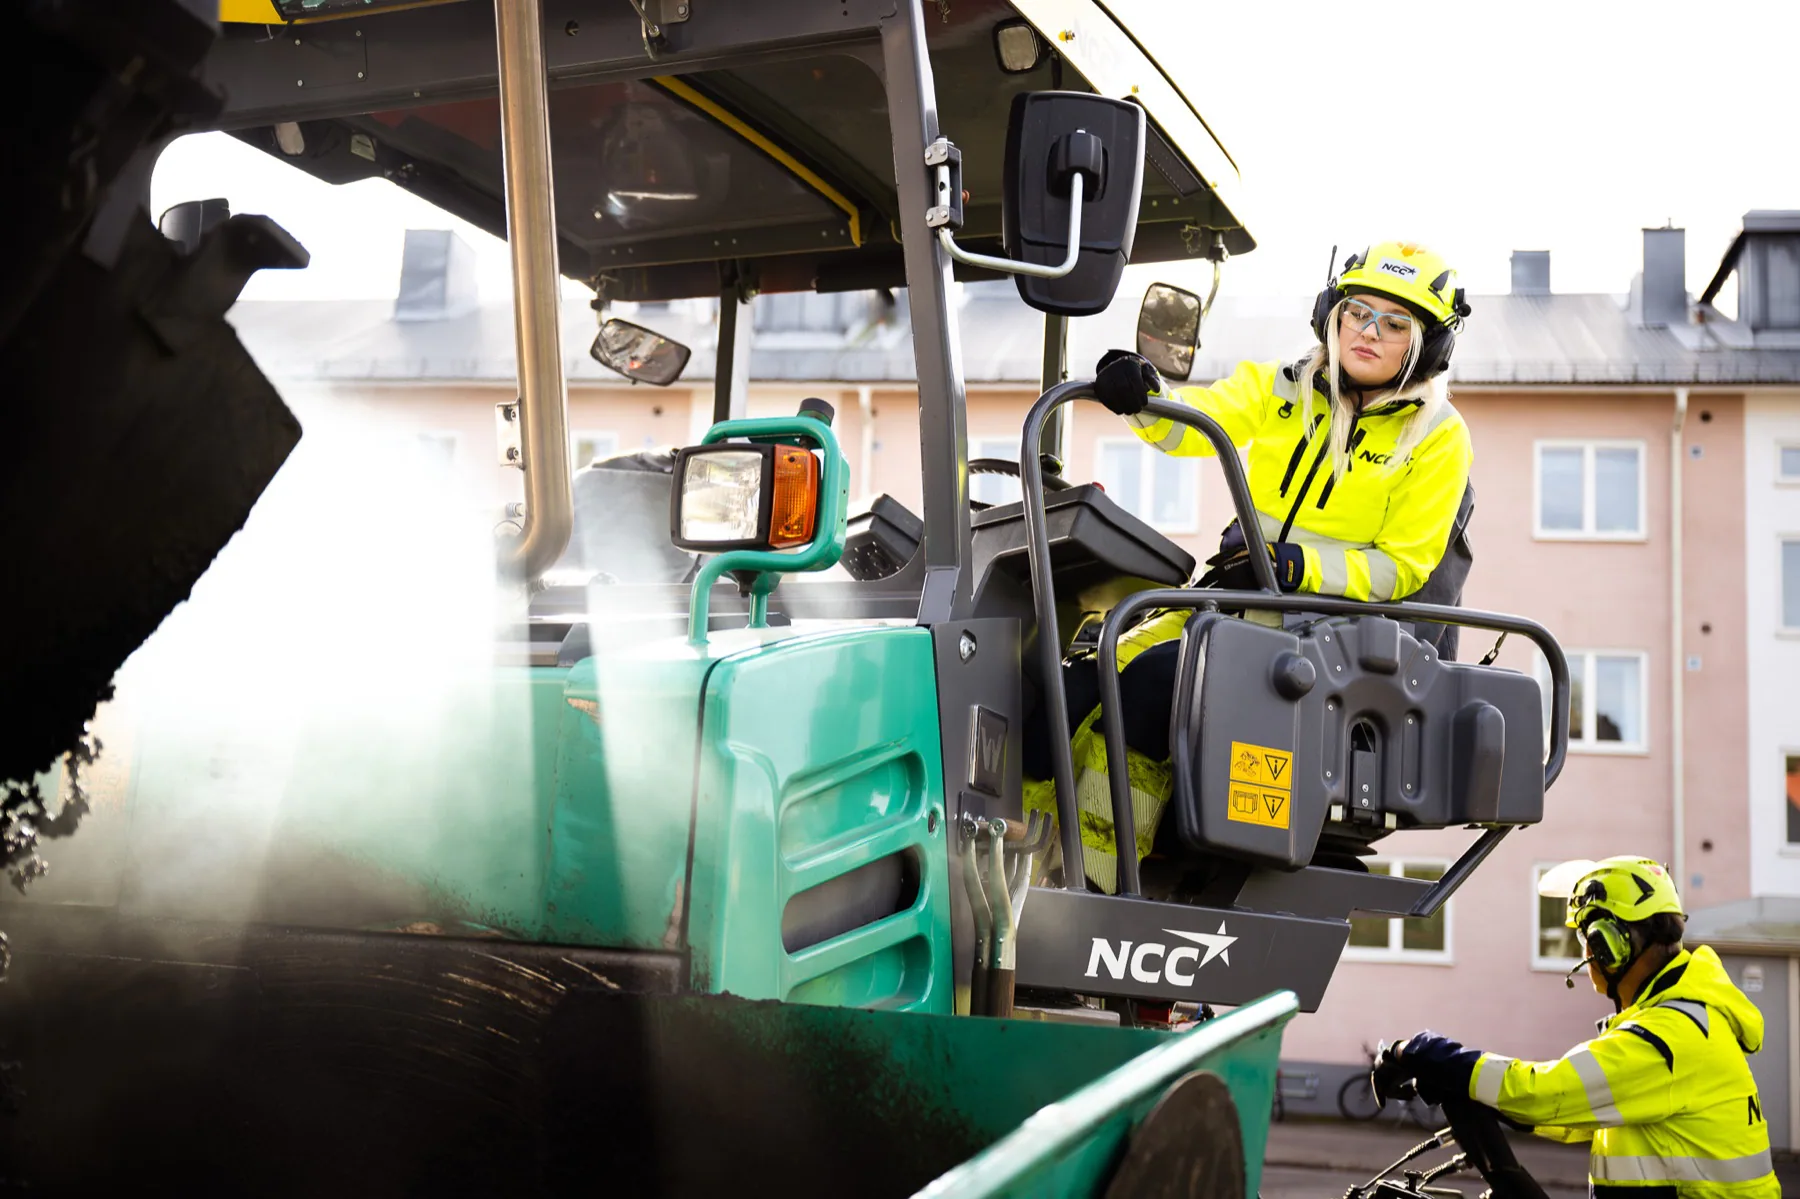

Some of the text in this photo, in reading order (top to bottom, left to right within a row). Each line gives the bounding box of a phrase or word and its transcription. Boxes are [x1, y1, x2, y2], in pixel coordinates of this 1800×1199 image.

[1382, 263, 1407, 276] NCC
[981, 726, 1004, 773] W
[1084, 937, 1200, 987] NCC
